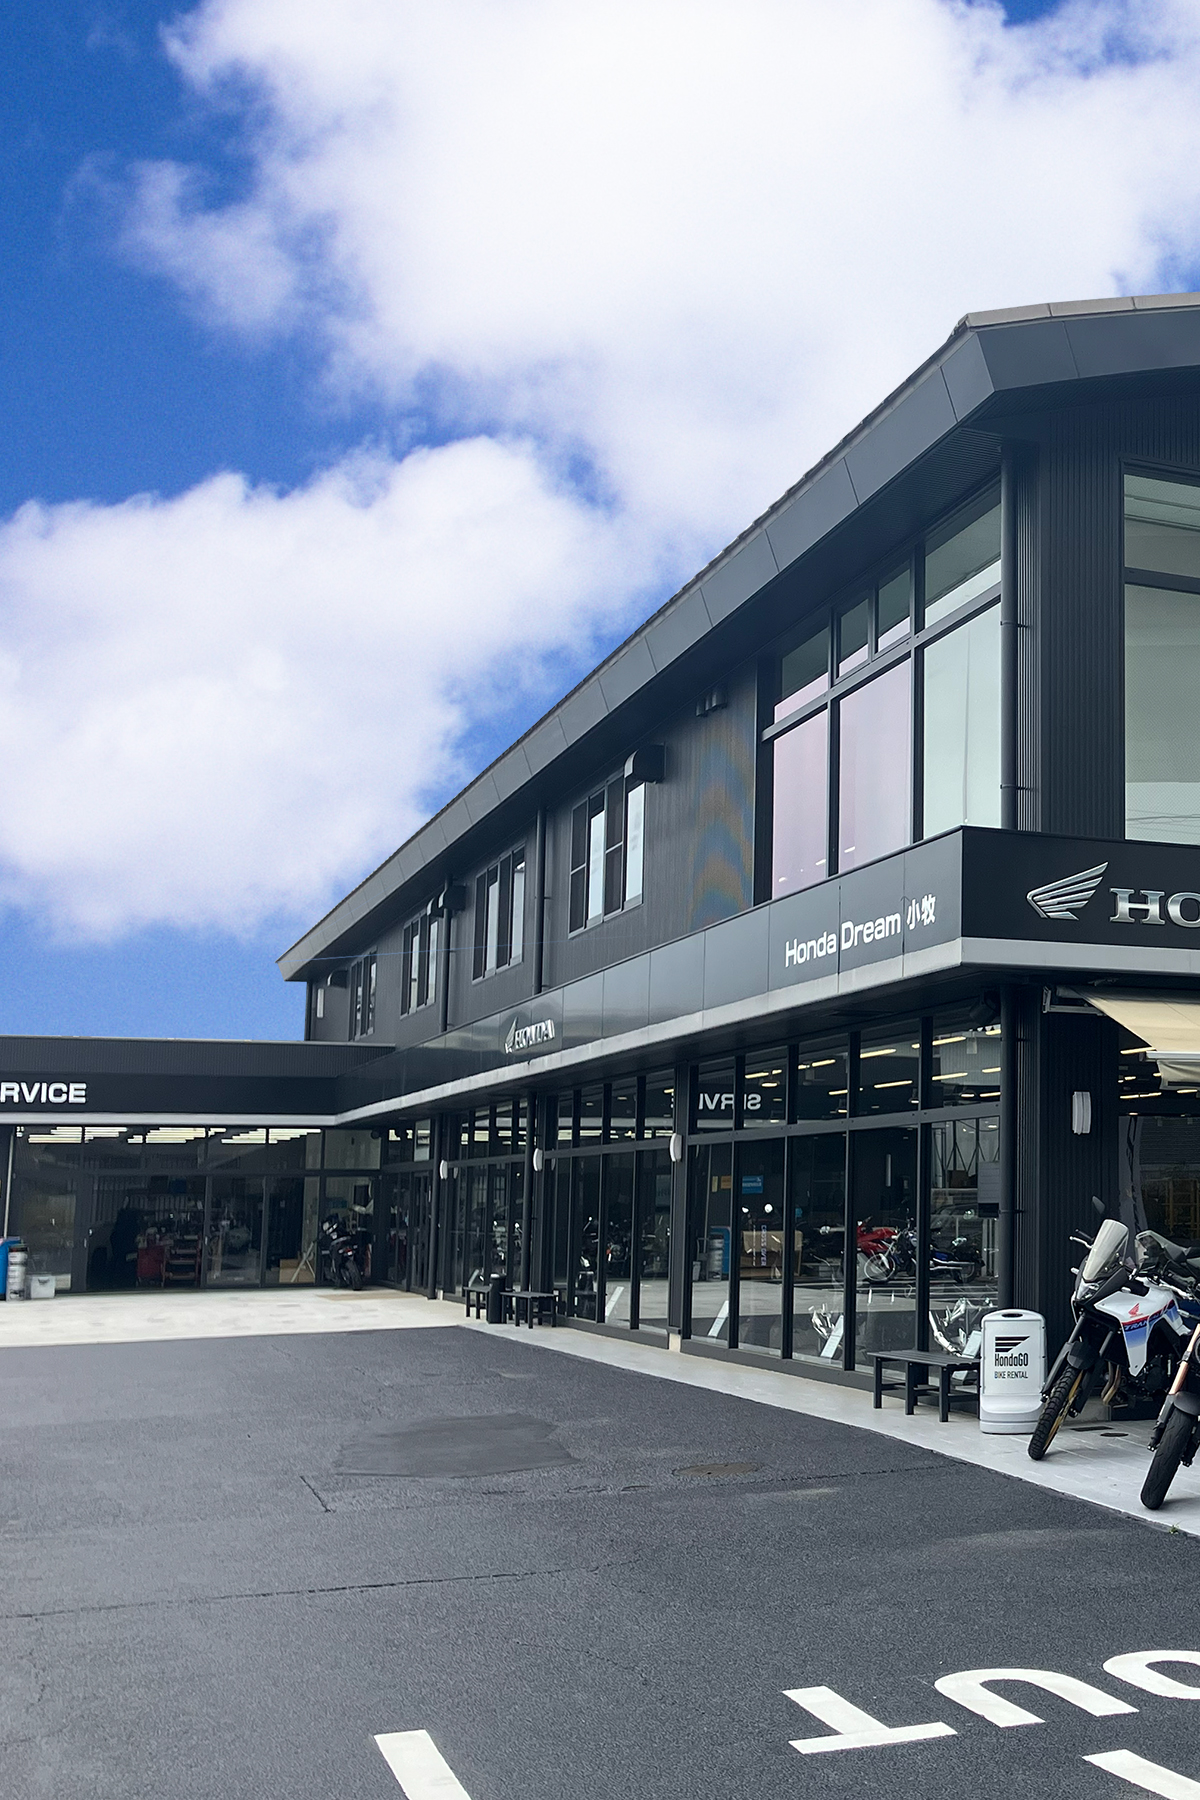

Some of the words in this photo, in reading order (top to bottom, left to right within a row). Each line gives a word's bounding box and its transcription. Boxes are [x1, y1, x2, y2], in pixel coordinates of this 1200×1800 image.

[785, 930, 837, 968] Honda
[841, 912, 901, 951] Dream
[906, 893, 937, 930] 小牧
[0, 1081, 87, 1104] RVICE
[994, 1352, 1028, 1367] HondaGO
[994, 1370, 1006, 1379] BIKE
[1007, 1370, 1028, 1379] RENTAL
